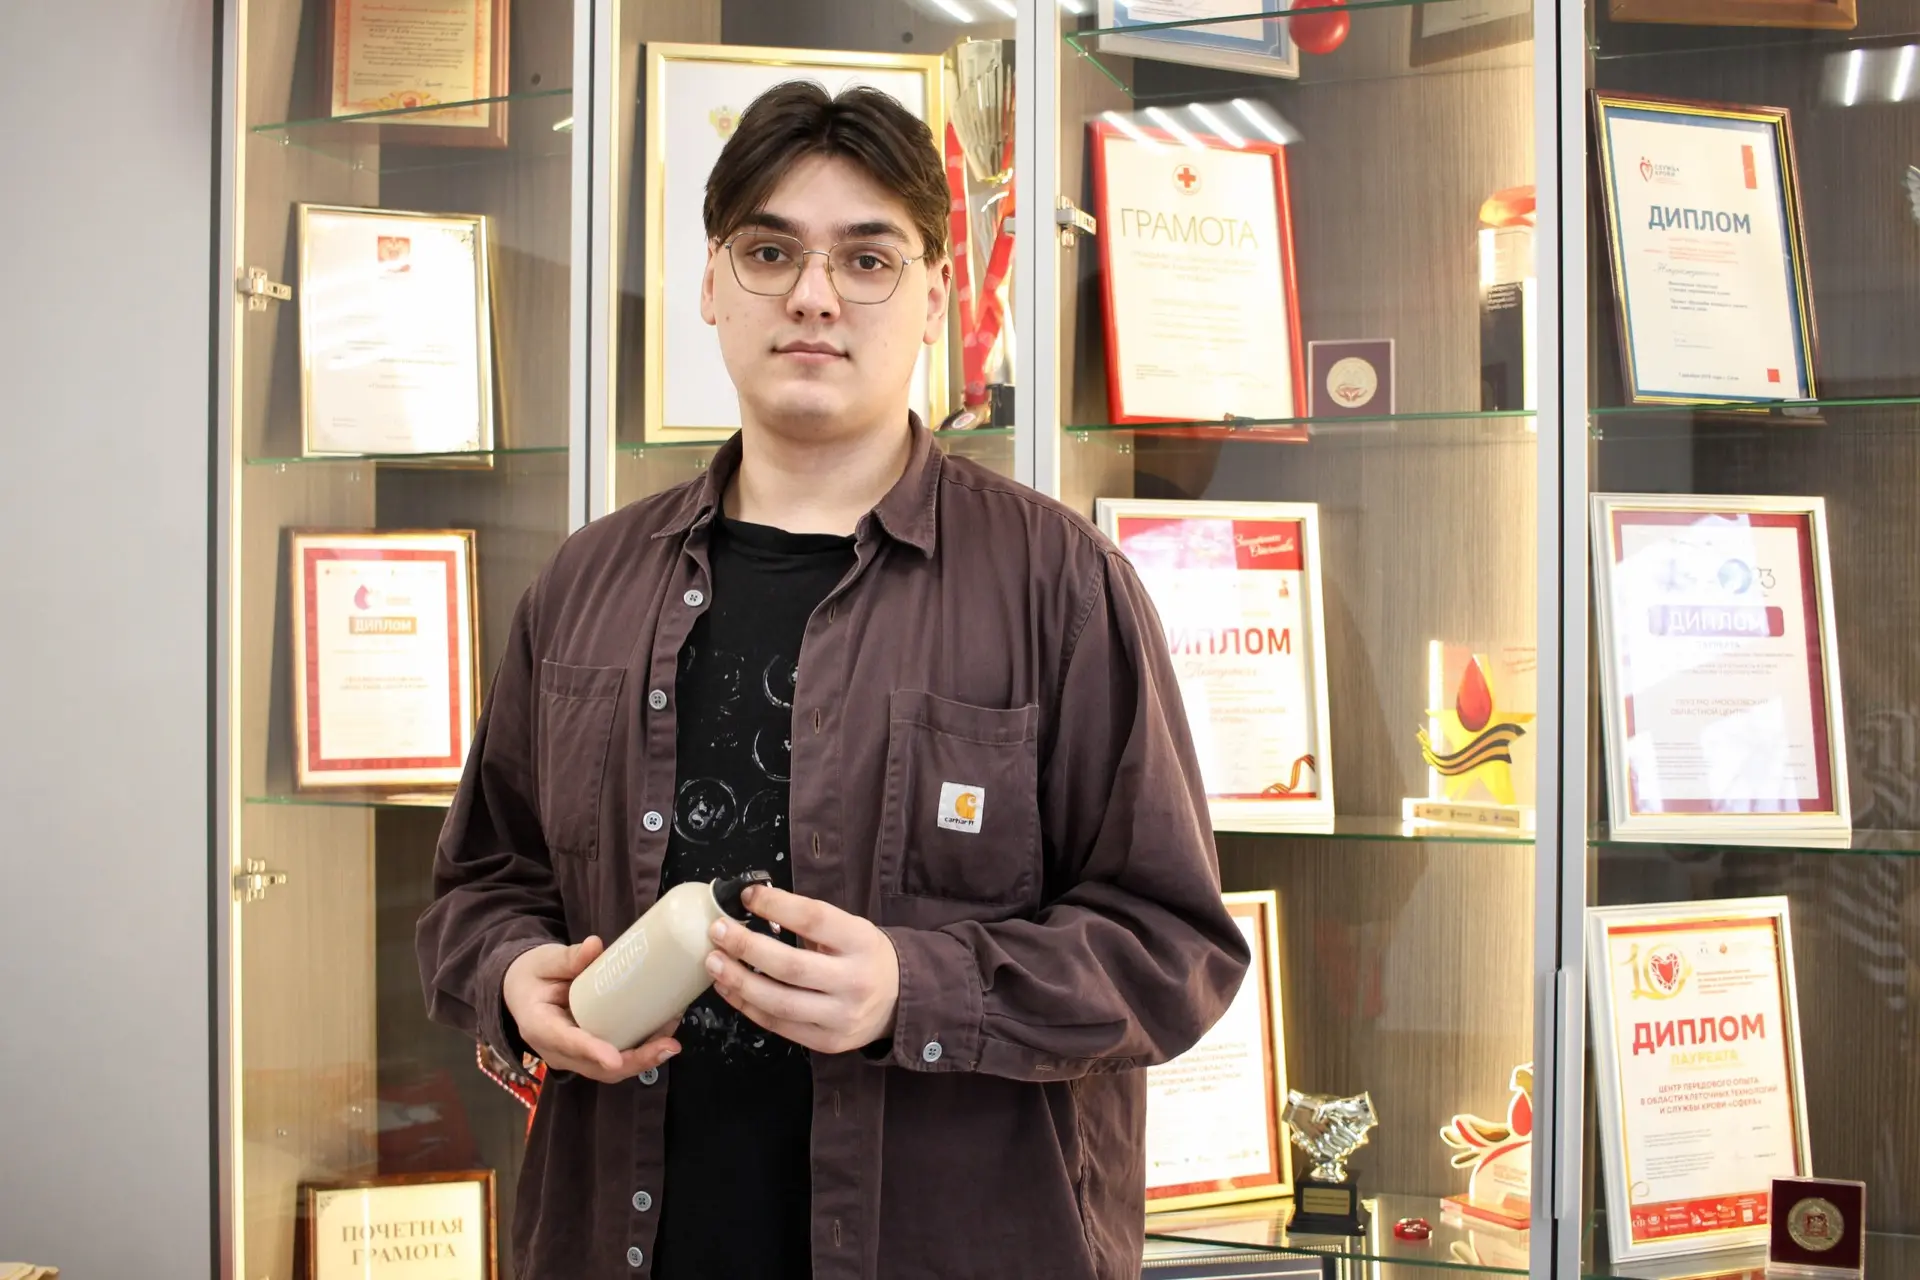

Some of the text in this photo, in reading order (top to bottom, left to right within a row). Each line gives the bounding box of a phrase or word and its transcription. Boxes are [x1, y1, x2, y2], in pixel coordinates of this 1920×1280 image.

[1121, 208, 1258, 249] ГРАМОТА
[1648, 204, 1751, 234] ДИПЛОМ
[355, 619, 412, 633] ДИПЛОМ
[1668, 609, 1768, 633] ДИПЛОМ
[1169, 627, 1291, 655] ИПЛОМ
[1633, 1013, 1766, 1056] ДИПЛОМ
[1671, 1049, 1739, 1066] ЛАУРЕАТА
[1647, 1094, 1683, 1105] ОБЛАСТИ
[1684, 1090, 1730, 1101] КЛЕТОЧНЫХ
[1731, 1084, 1778, 1097] ТЕХНОЛОГИЙ
[1658, 1077, 1760, 1093] ЦЕНТР ПЕРЕДОВОГО ОПЫТА
[1666, 1104, 1700, 1114] СЛУЖБЫ
[1701, 1101, 1727, 1110] КРОВИ
[342, 1217, 463, 1242] ПОЧЕТНАЯ
[352, 1243, 457, 1265] ГРАМОТА
